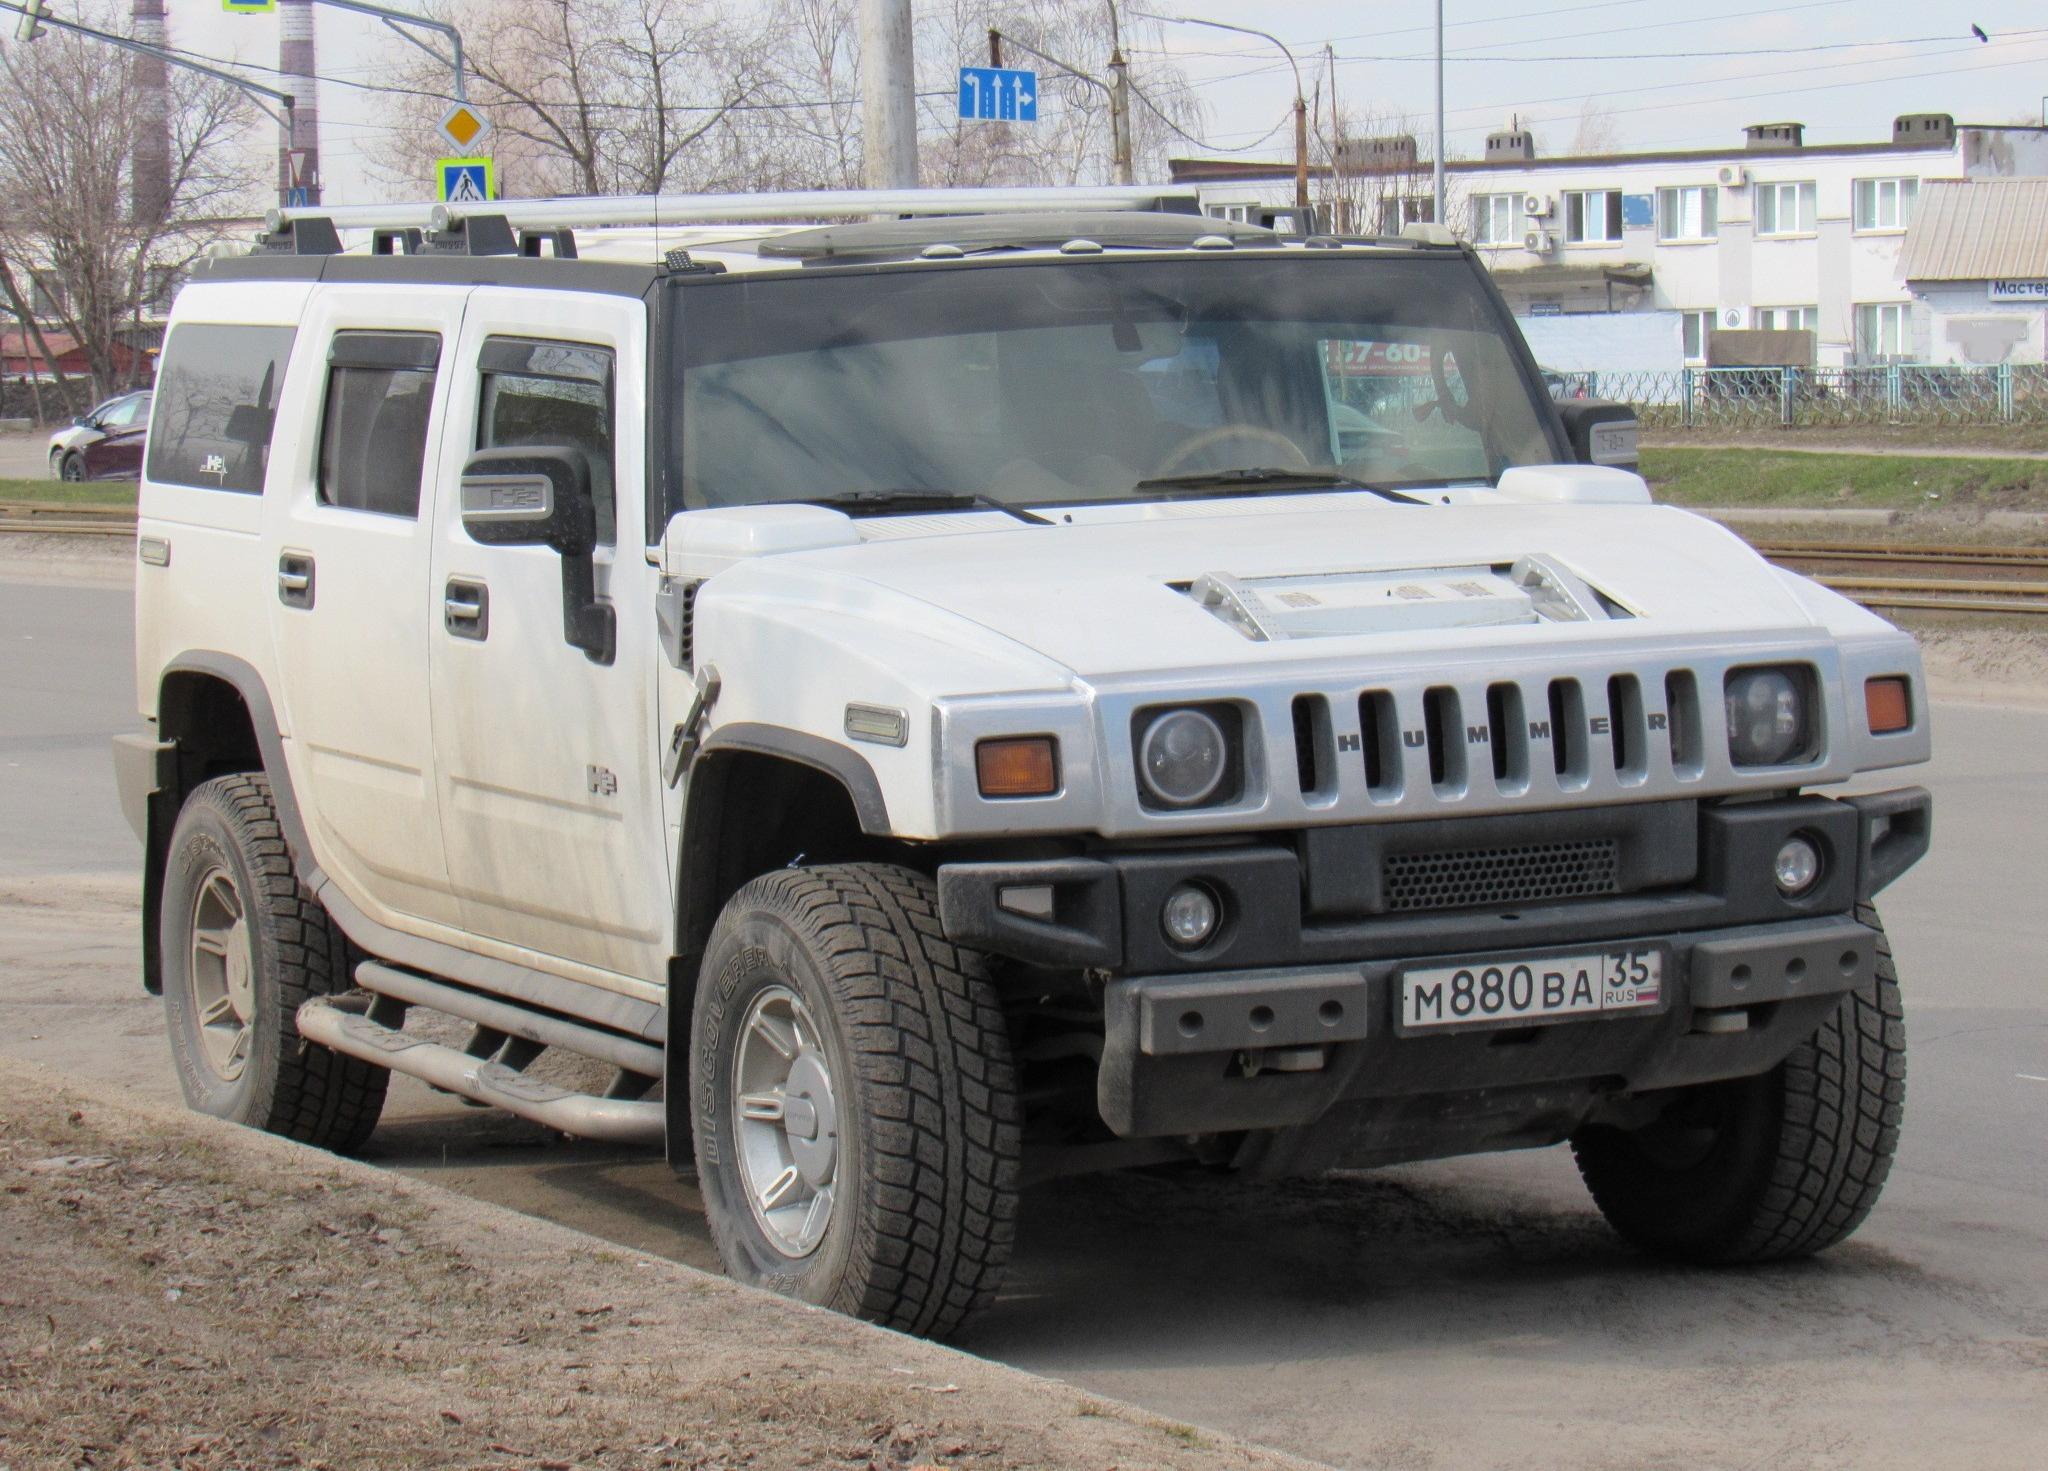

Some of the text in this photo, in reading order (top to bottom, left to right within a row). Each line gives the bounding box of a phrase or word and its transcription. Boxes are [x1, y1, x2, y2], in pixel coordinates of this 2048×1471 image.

[1337, 711, 1667, 752] HUMMER
[586, 764, 618, 796] H2
[1608, 950, 1649, 988] 35
[1604, 988, 1635, 1004] RUS
[701, 945, 769, 1166] DISCOVERER
